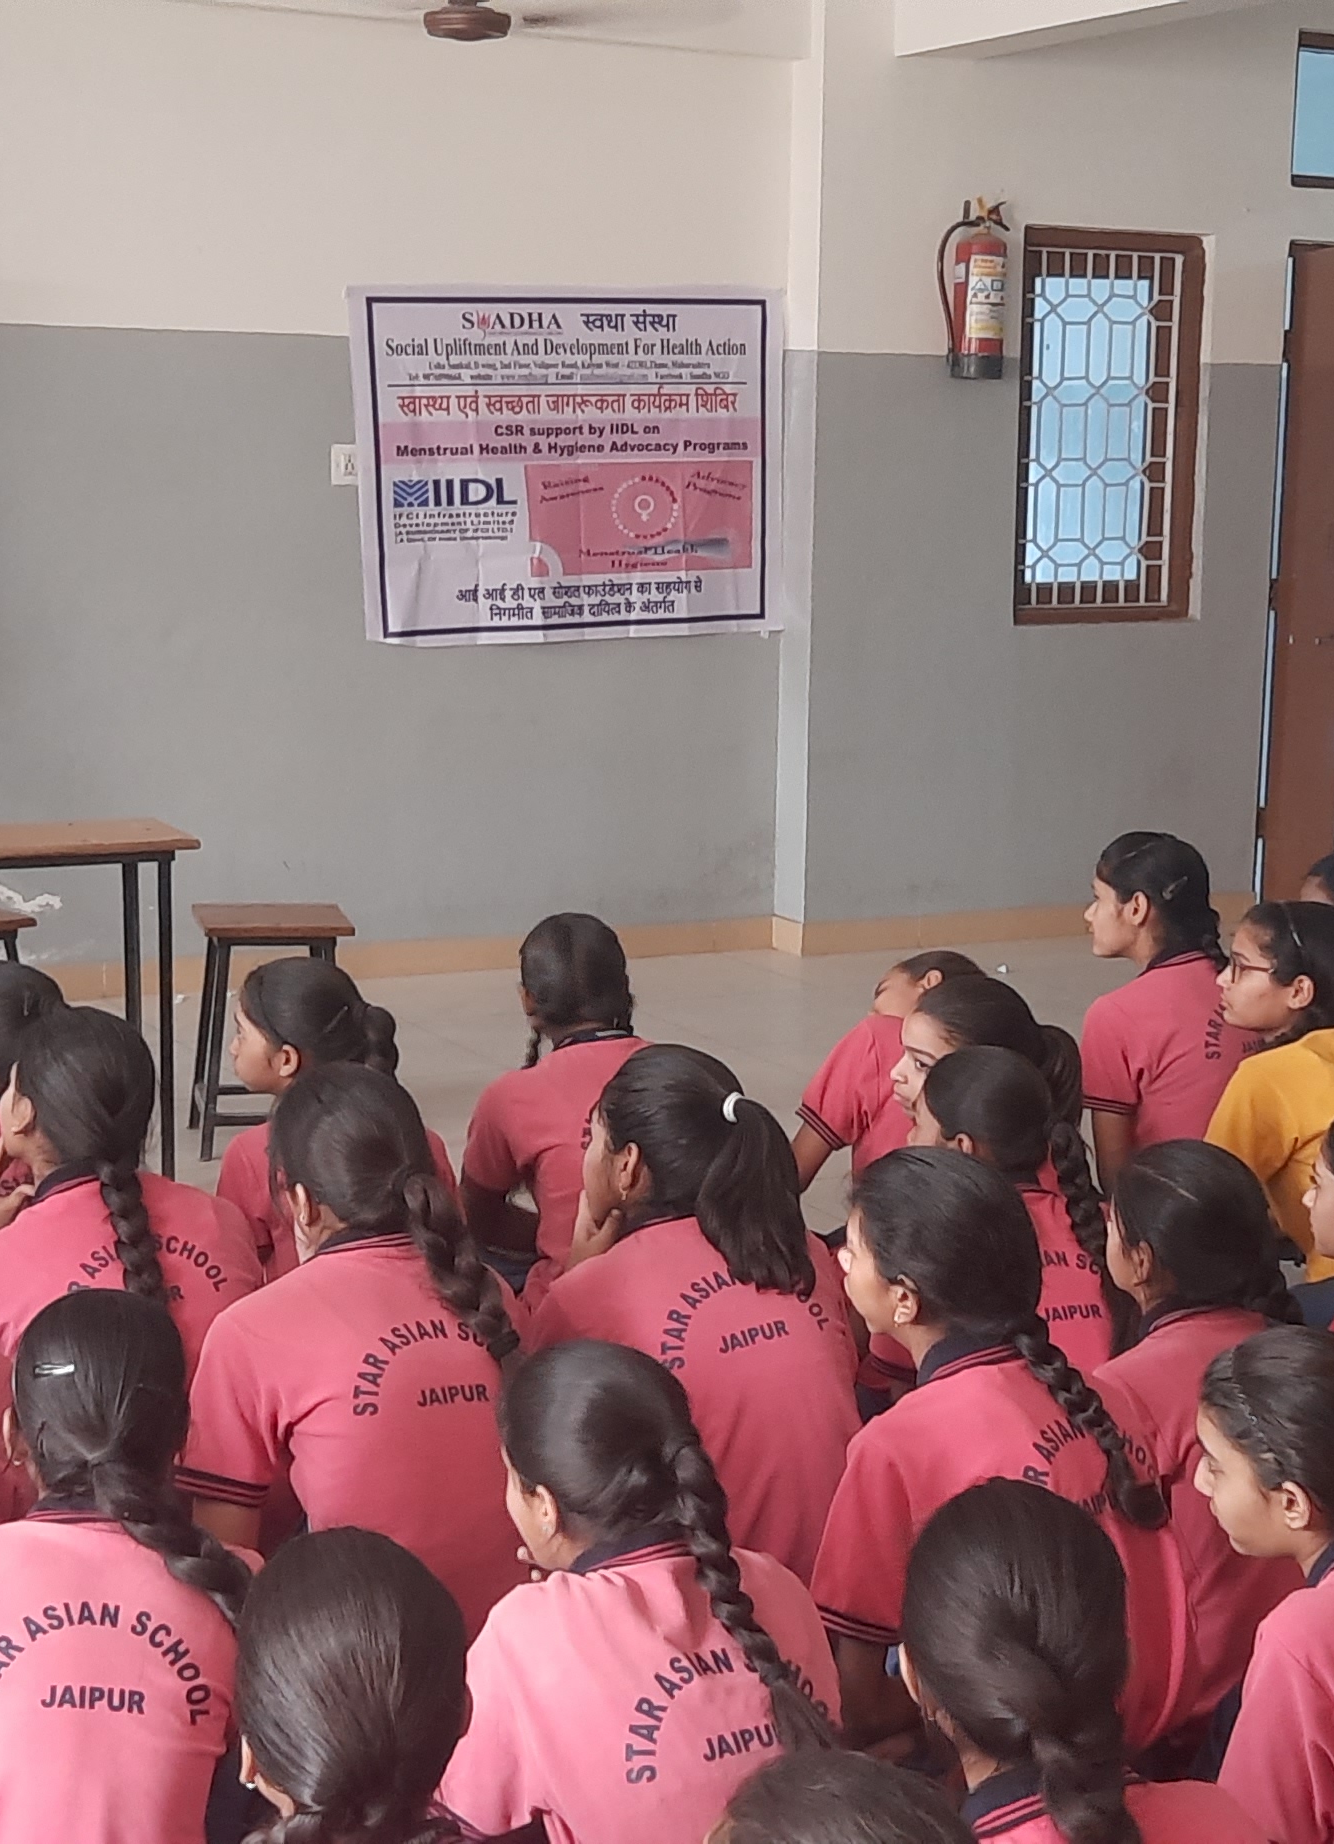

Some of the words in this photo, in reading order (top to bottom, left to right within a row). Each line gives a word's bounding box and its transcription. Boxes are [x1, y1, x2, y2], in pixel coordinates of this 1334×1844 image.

[580, 313, 626, 333] स्वधा
[630, 309, 678, 333] संस्था
[385, 338, 430, 357] Social
[434, 337, 508, 364] Upliftment
[511, 338, 540, 357] And
[544, 337, 630, 362] Development
[633, 338, 657, 356] For
[660, 337, 704, 356] Health
[705, 338, 747, 356] Action
[397, 395, 451, 416] स्वास्थ्य
[455, 389, 480, 419] एवं
[483, 393, 542, 416] स्वच्छता
[545, 393, 627, 415] जागरूकता
[630, 385, 690, 414] कार्यक्रम
[694, 386, 739, 414] शिबिर
[494, 424, 525, 437] CSR
[529, 425, 584, 439] support
[588, 423, 605, 438] by
[609, 423, 639, 435] IIDL
[643, 425, 661, 435] on
[396, 443, 474, 457] Menstrual
[478, 442, 528, 456] Health
[532, 442, 543, 455] &
[547, 440, 605, 457] Hygiene
[609, 440, 679, 455] Advocacy
[683, 440, 749, 454] Programs
[432, 477, 519, 507] IIDL
[423, 510, 518, 520] Infrastructure
[636, 582, 652, 596] का
[1204, 1018, 1224, 1060] STAR
[719, 1320, 790, 1354] JAIPUR
[352, 1353, 390, 1417] STAR
[378, 1319, 449, 1357] ASIAN
[417, 1384, 490, 1408] JAIPUR
[22, 1601, 121, 1642] ASIAN
[130, 1610, 212, 1727] SCHOOL
[40, 1684, 146, 1715] JAIPUR
[625, 1696, 669, 1785] STAR
[654, 1647, 735, 1700] ASIAN
[702, 1722, 779, 1762] JAIPU
